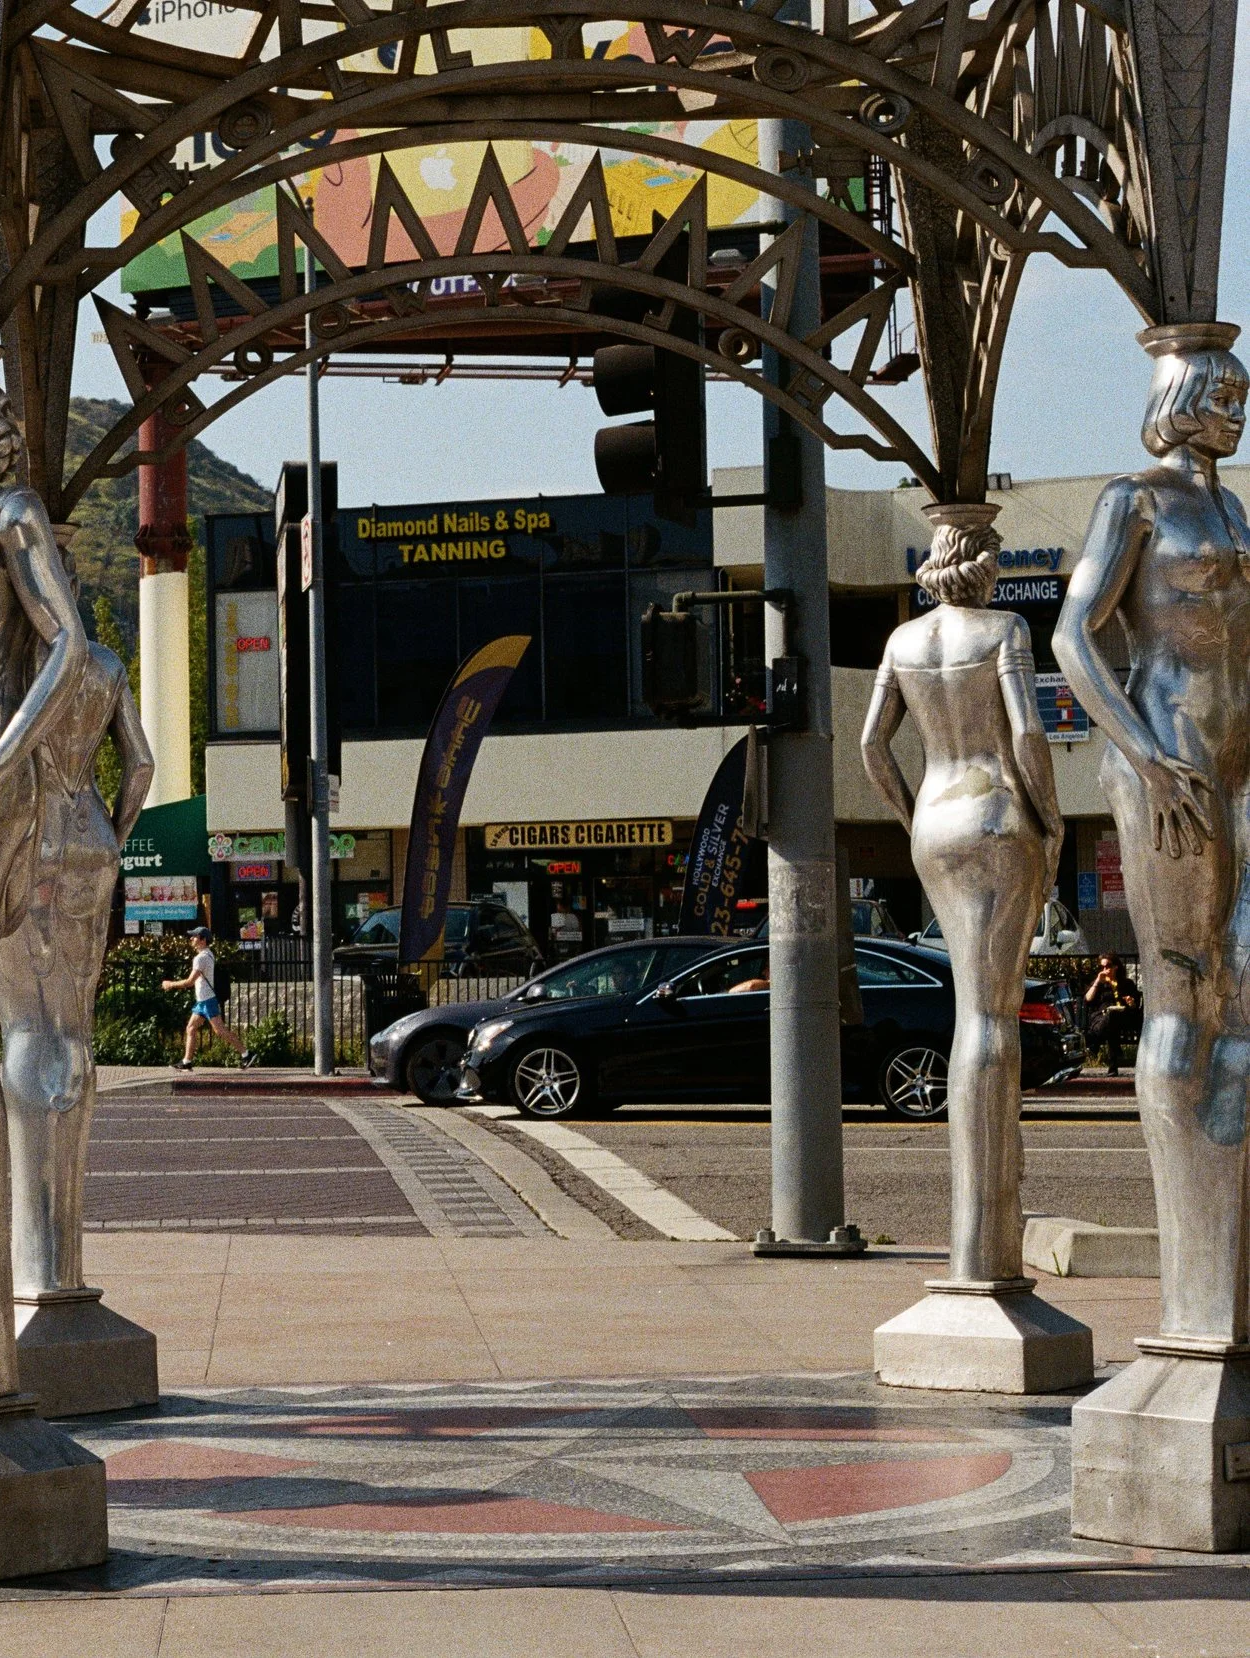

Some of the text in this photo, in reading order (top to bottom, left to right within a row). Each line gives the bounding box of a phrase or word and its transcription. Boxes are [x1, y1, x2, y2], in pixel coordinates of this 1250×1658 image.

[357, 508, 550, 539] Diamond Nails & Spa
[398, 540, 506, 563] TANNING
[236, 637, 270, 651] OPEN
[509, 822, 666, 846] CIGARS CIGARETTE
[119, 853, 163, 870] ogurt
[547, 862, 581, 874] OPEN
[692, 827, 711, 886] HOLLYWOOD
[694, 871, 712, 917] GOLD
[706, 803, 730, 856] SILVER
[711, 840, 727, 888] EXCHANGE
[238, 865, 269, 879] OPEN
